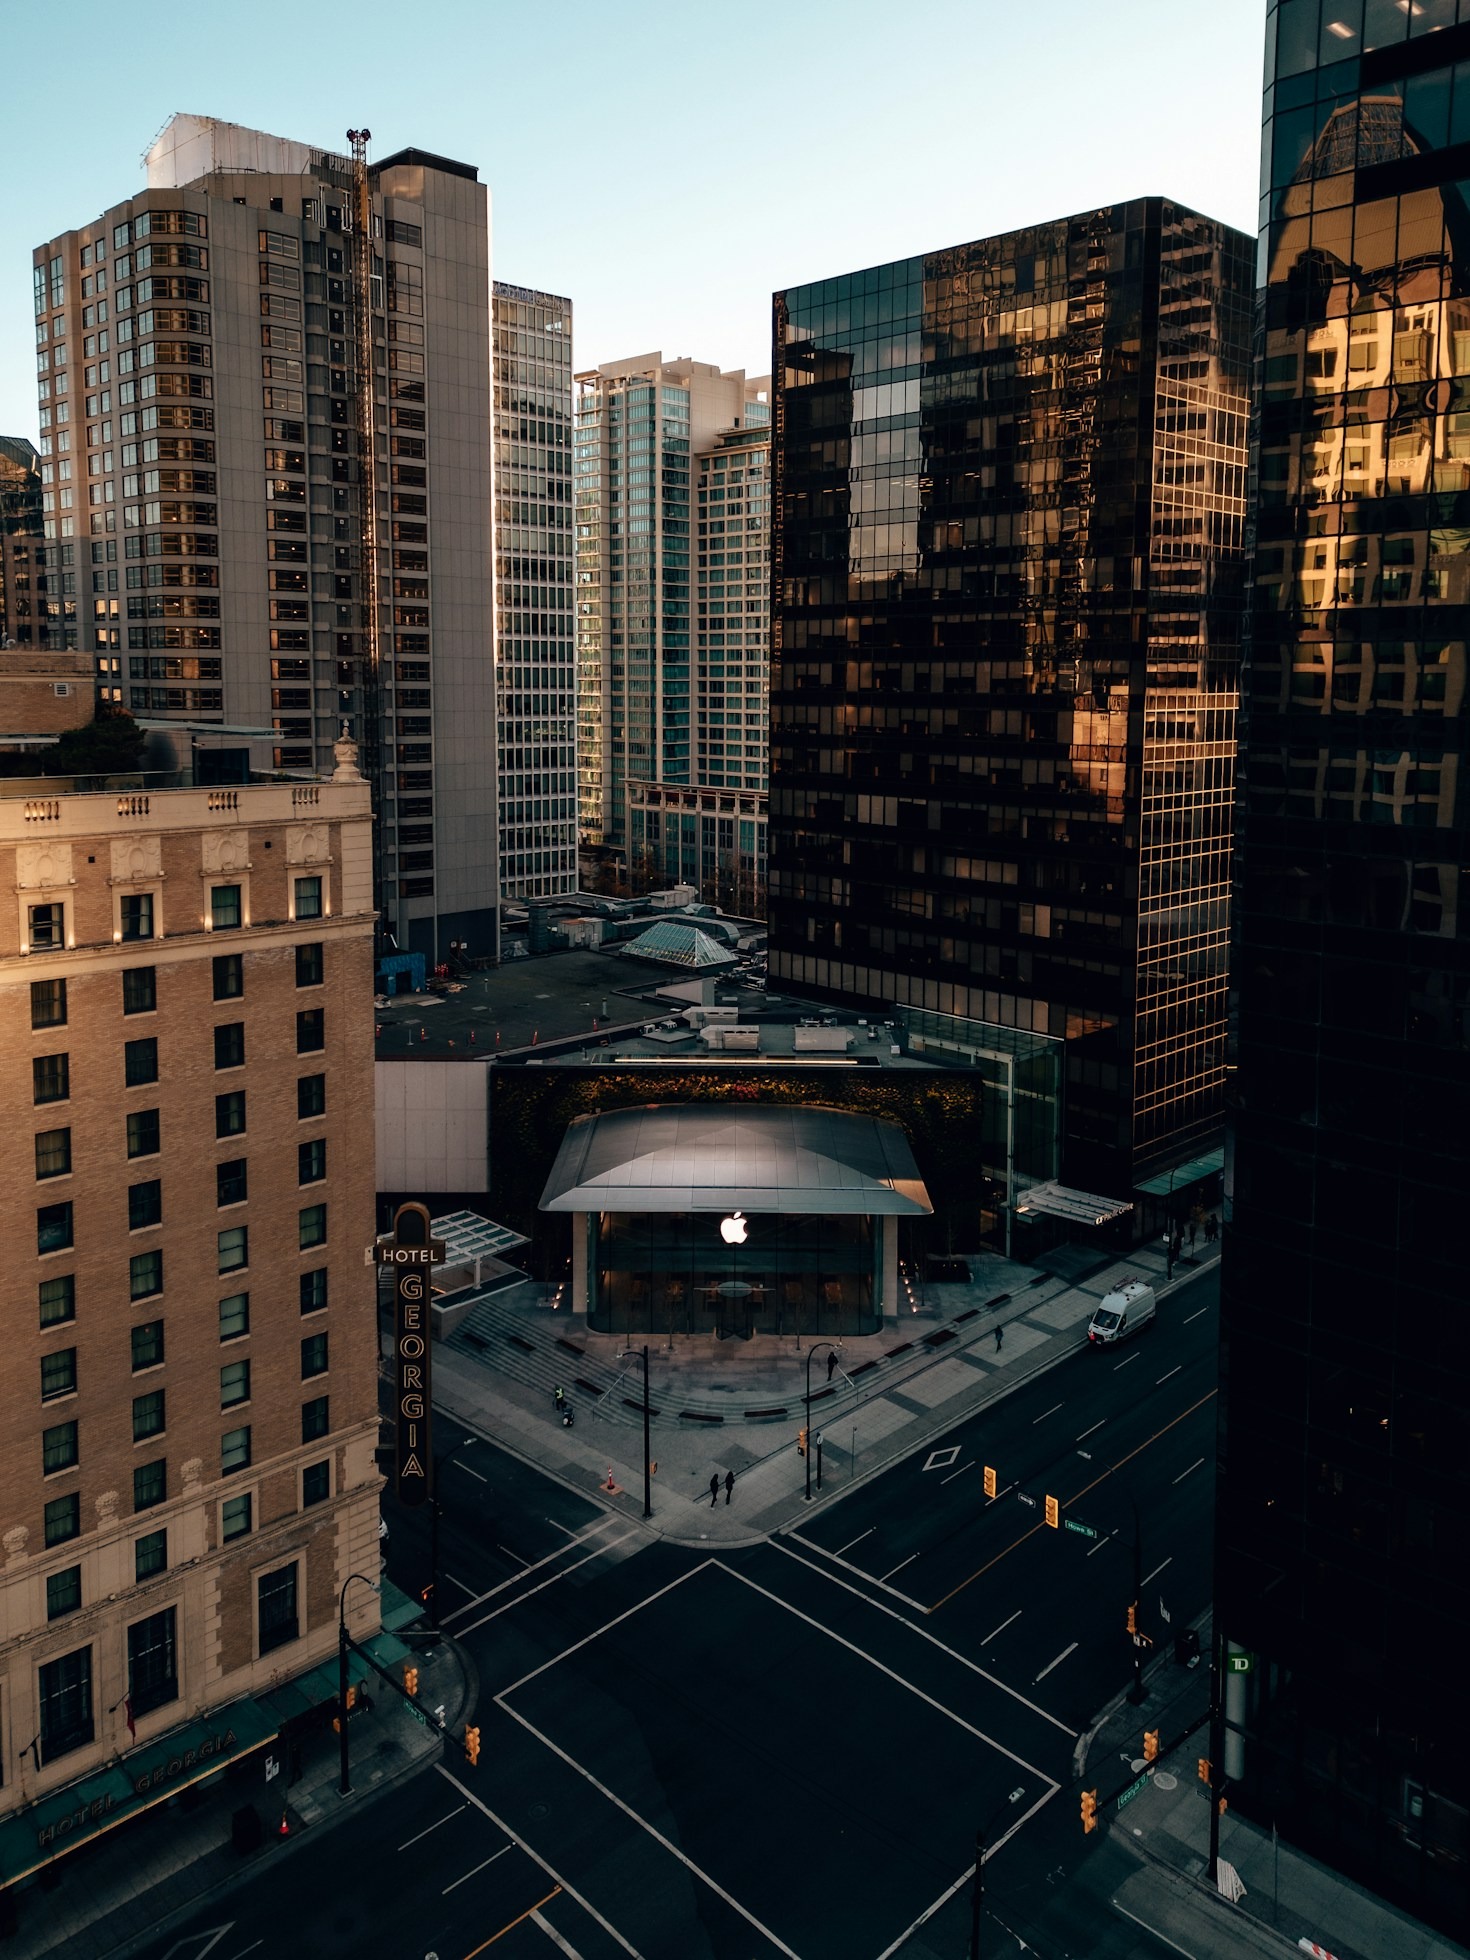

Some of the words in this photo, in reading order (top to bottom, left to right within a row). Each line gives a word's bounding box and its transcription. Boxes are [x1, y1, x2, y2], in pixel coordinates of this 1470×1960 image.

[383, 1249, 438, 1263] HOTEL
[399, 1273, 425, 1477] GEORGIA
[1231, 1658, 1249, 1670] TD
[38, 1791, 116, 1847] HOTEL
[135, 1728, 237, 1793] GEORGIA
